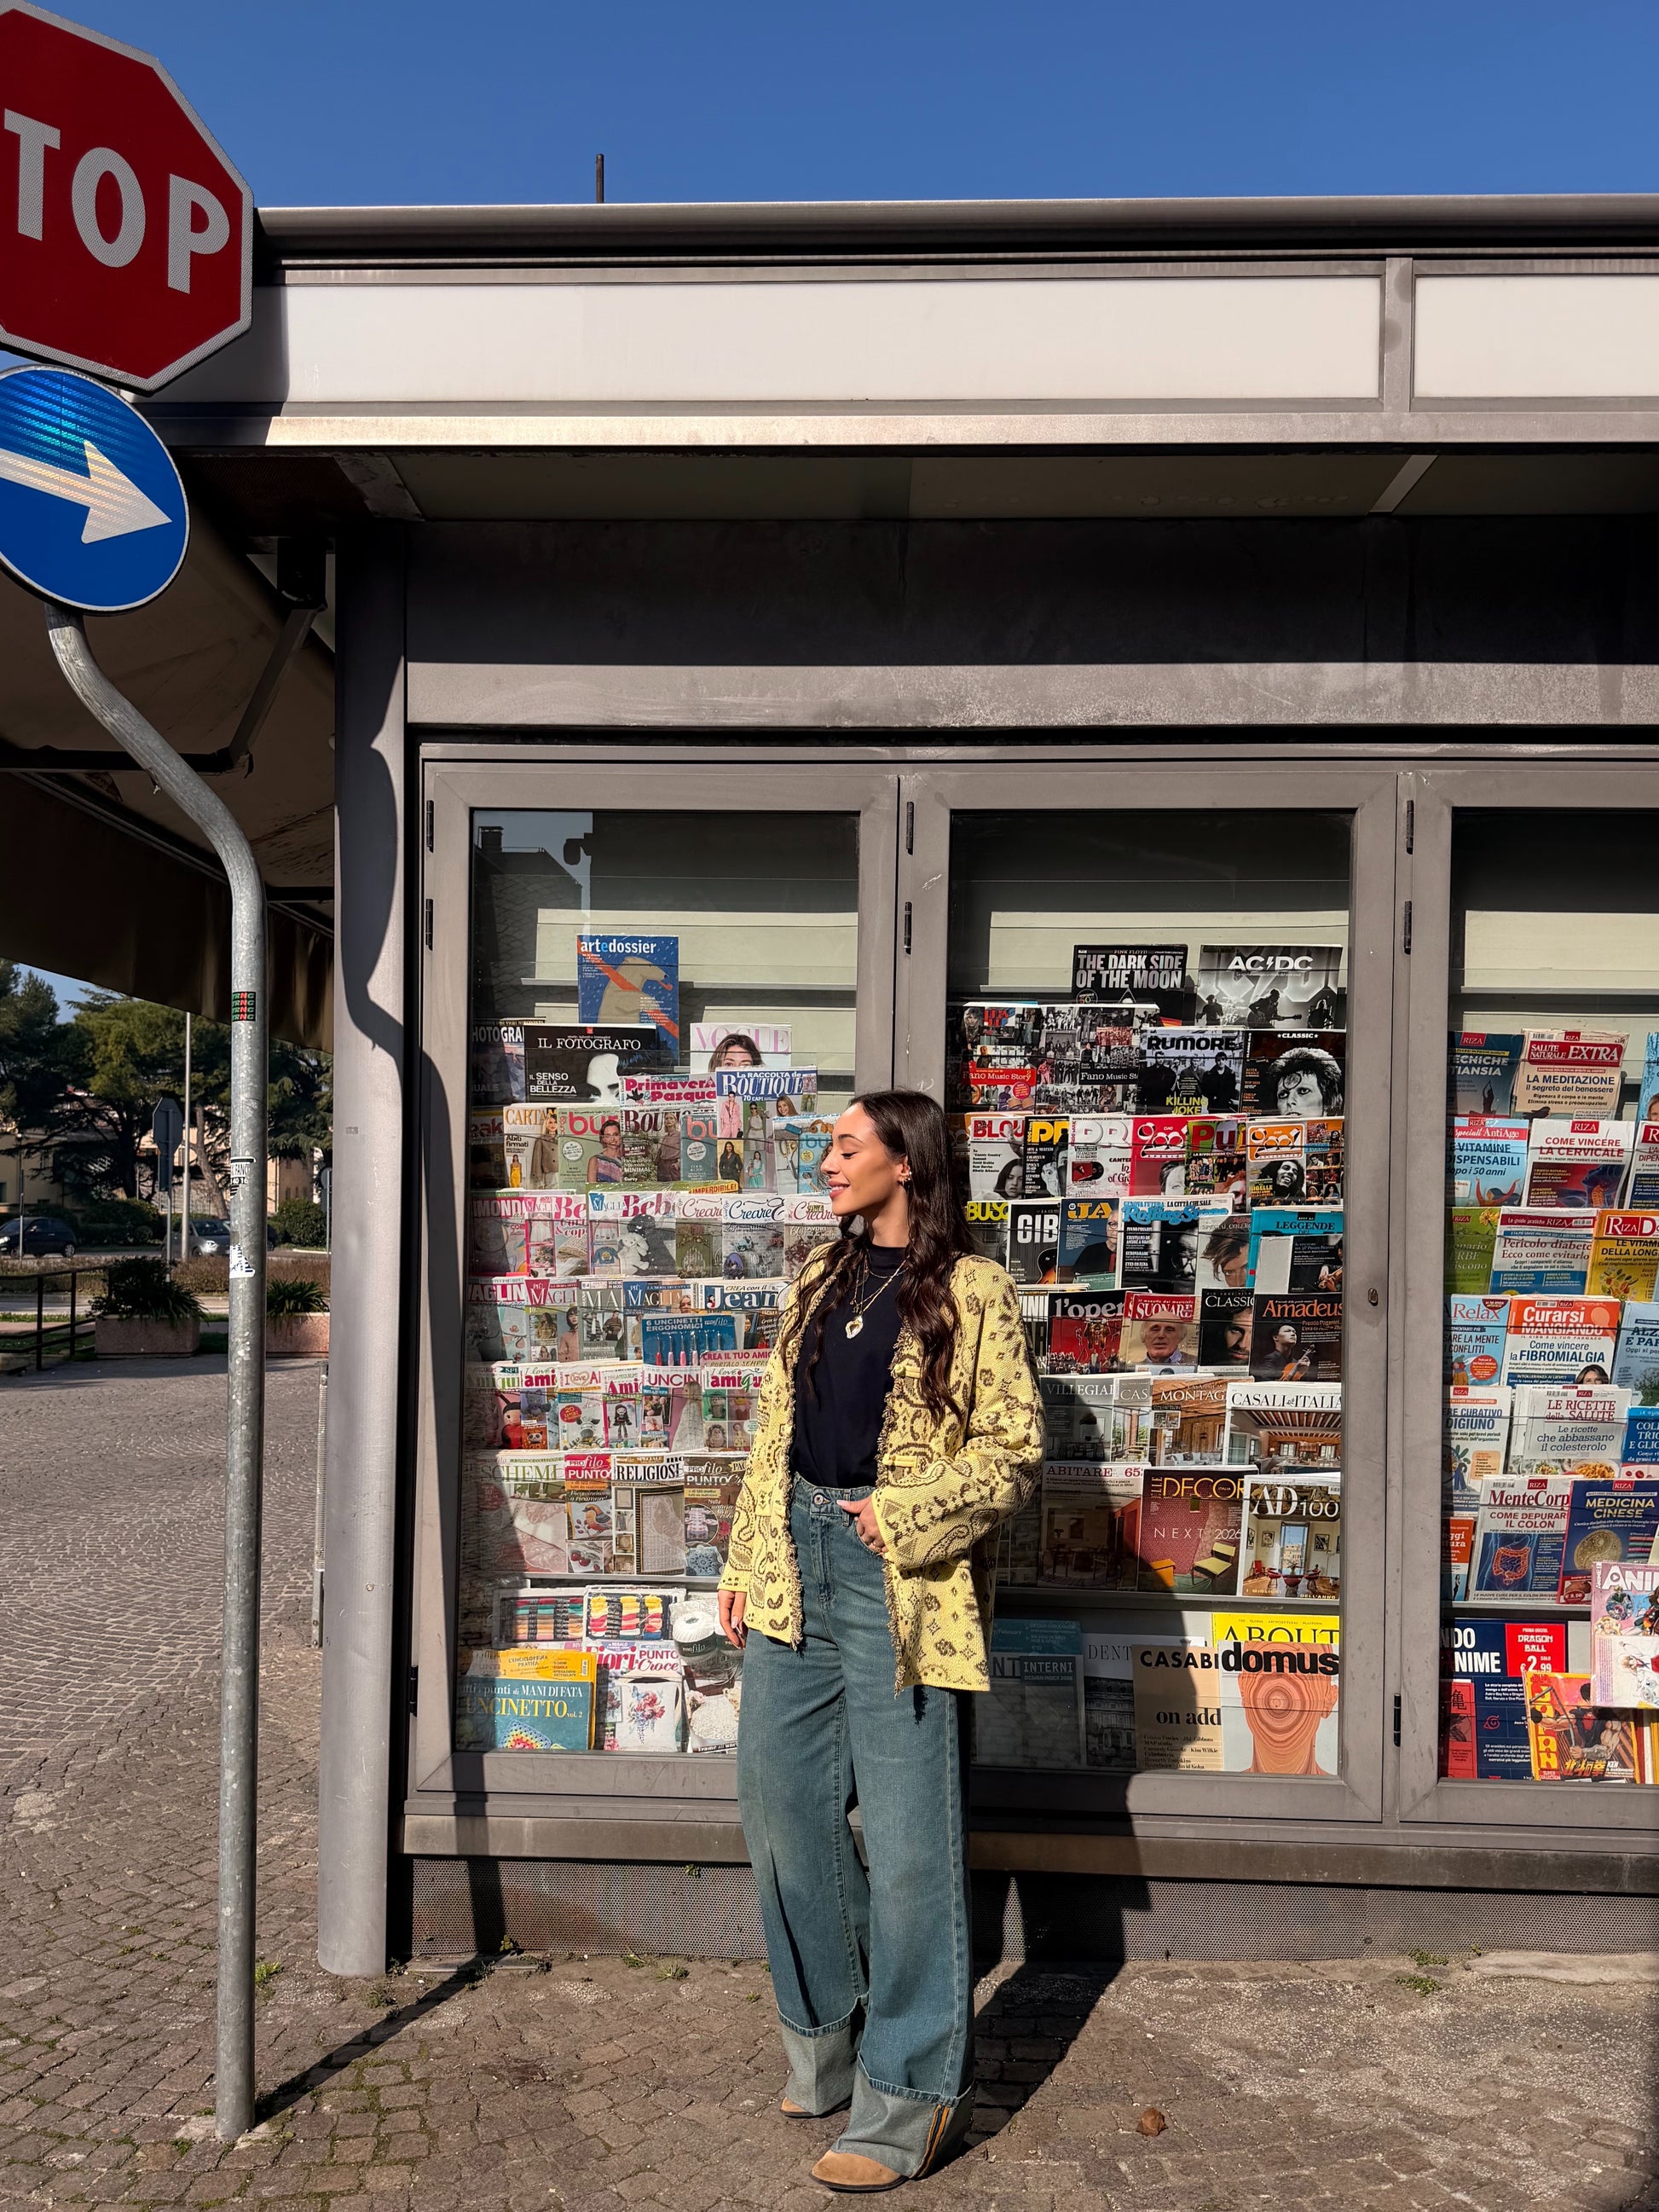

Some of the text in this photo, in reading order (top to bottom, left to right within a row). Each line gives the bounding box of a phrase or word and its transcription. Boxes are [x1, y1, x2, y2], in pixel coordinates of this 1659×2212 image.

[581, 939, 656, 954] artedossier
[1078, 955, 1183, 970] THE DARK SIDE
[1076, 970, 1182, 989] OF THE MOON
[538, 1038, 641, 1050] IL FOTOGRAFO
[1530, 1051, 1566, 1060] NATURALE
[1568, 1046, 1619, 1061] EXTRA
[722, 1074, 803, 1097] BOUTIQUE
[1543, 1075, 1615, 1086] MEDITAZIONE
[529, 1085, 576, 1093] BELLEZZA
[650, 1091, 716, 1102] Pasqua
[1166, 1097, 1208, 1106] KILLING
[1172, 1106, 1201, 1115] JOKE
[1483, 1127, 1519, 1138] AntiAge
[1458, 1143, 1511, 1153] VITAMINE
[1578, 1138, 1621, 1147] VINCERE
[1558, 1148, 1624, 1157] CERVICALE
[1473, 1167, 1484, 1175] 50
[1122, 1207, 1182, 1225] Rolling
[1276, 1221, 1335, 1230] LEGGENDE
[1607, 1217, 1638, 1235] RIZA
[1503, 1238, 1592, 1250] Pericolo diabete
[1501, 1250, 1523, 1259] Ecco
[1553, 1251, 1589, 1260] evitarlo
[1453, 1303, 1500, 1319] Relax
[1523, 1306, 1584, 1323] Curarsi
[1522, 1322, 1604, 1335] MANGIANDO
[1475, 1335, 1500, 1344] MENTE
[1529, 1341, 1589, 1351] Come vincere
[1519, 1350, 1605, 1363] FIBROMIALGIA
[1232, 1393, 1286, 1406] CASALI
[1547, 1400, 1616, 1410] LE RICETTE
[1460, 1409, 1502, 1417] CURATIVO
[1546, 1411, 1615, 1421] della SALUTE
[1541, 1443, 1607, 1451] il colesterolo
[569, 1469, 609, 1479] PUNTO
[1047, 1467, 1113, 1477] ABITARE
[687, 1476, 727, 1485] PUNTO
[1251, 1486, 1340, 1517] AD 100
[1489, 1490, 1569, 1510] MenteCorp
[1586, 1498, 1655, 1508] MEDICINA
[1490, 1512, 1518, 1520] COME
[1593, 1508, 1644, 1519] CINESE
[1518, 1520, 1555, 1529] COLON
[1154, 1528, 1203, 1540] NEXT
[1222, 1642, 1339, 1676] domus
[638, 1659, 679, 1671] Croce
[1023, 1662, 1072, 1673] INTERNI
[484, 1685, 511, 1696] punti
[522, 1685, 546, 1695] MANI
[560, 1687, 583, 1697] FATA
[1156, 1708, 1222, 1726] on add
